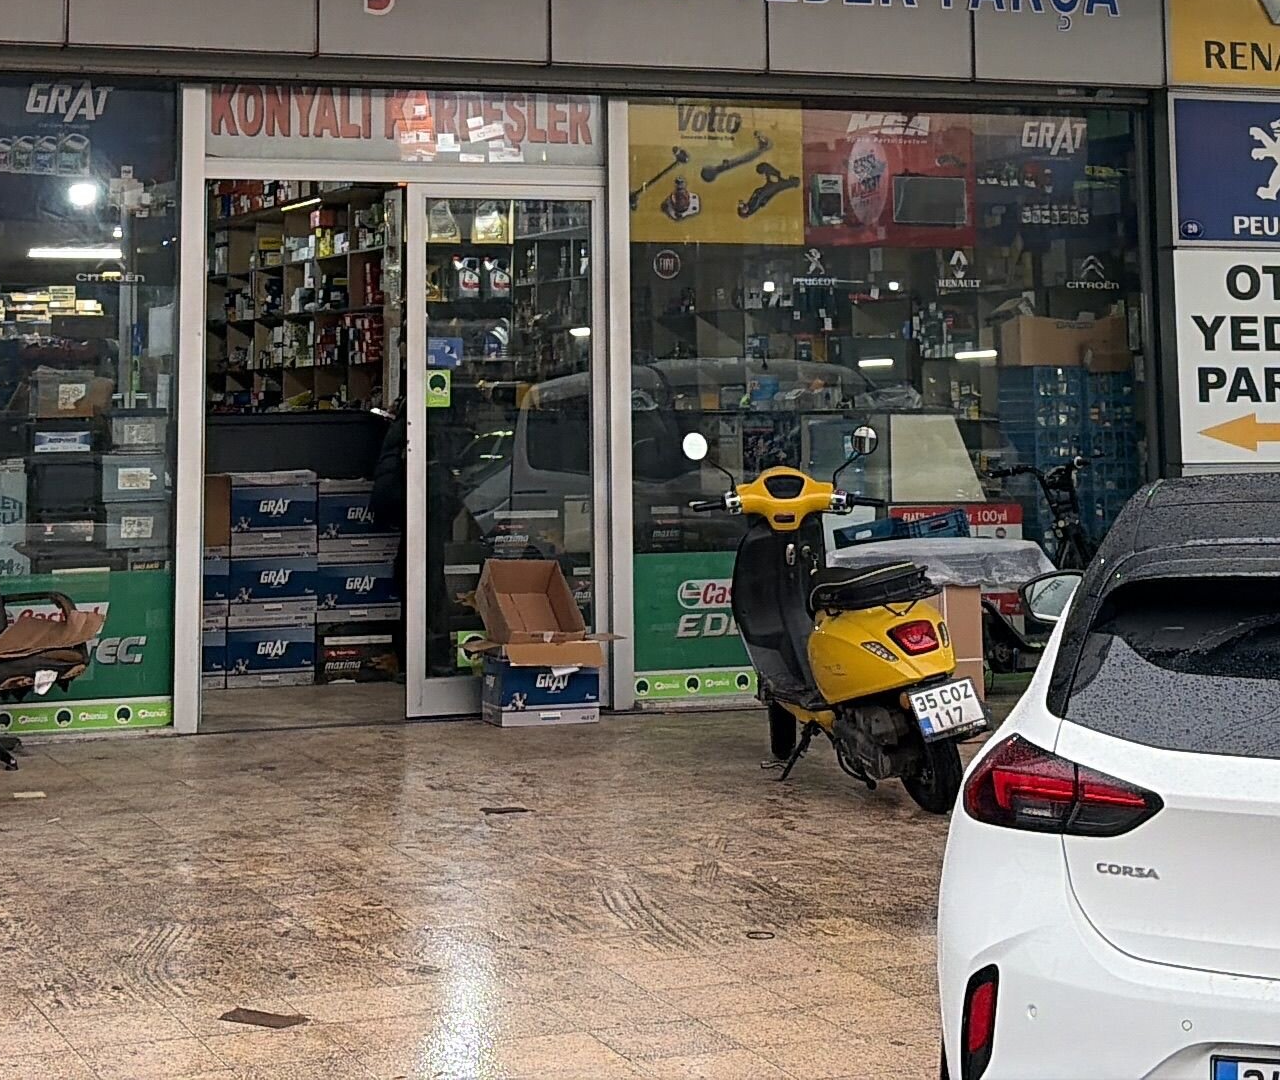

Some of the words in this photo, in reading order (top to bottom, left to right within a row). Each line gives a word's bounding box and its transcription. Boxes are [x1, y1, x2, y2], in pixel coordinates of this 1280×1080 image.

[25, 80, 115, 123] GRAT
[210, 80, 372, 140] KONYALI
[1022, 118, 1087, 155] GRAT
[938, 279, 980, 288] RENAULT
[1066, 280, 1120, 290] CITROËN
[258, 497, 291, 515] GRAT
[977, 510, 1008, 524] 100yıl
[260, 568, 293, 586] GRAT
[345, 575, 377, 592] GRAT
[256, 639, 289, 658] GRAT
[324, 660, 362, 671] maxima
[914, 692, 938, 712] 35
[935, 705, 963, 729] 117
[1095, 861, 1160, 881] CORSA
